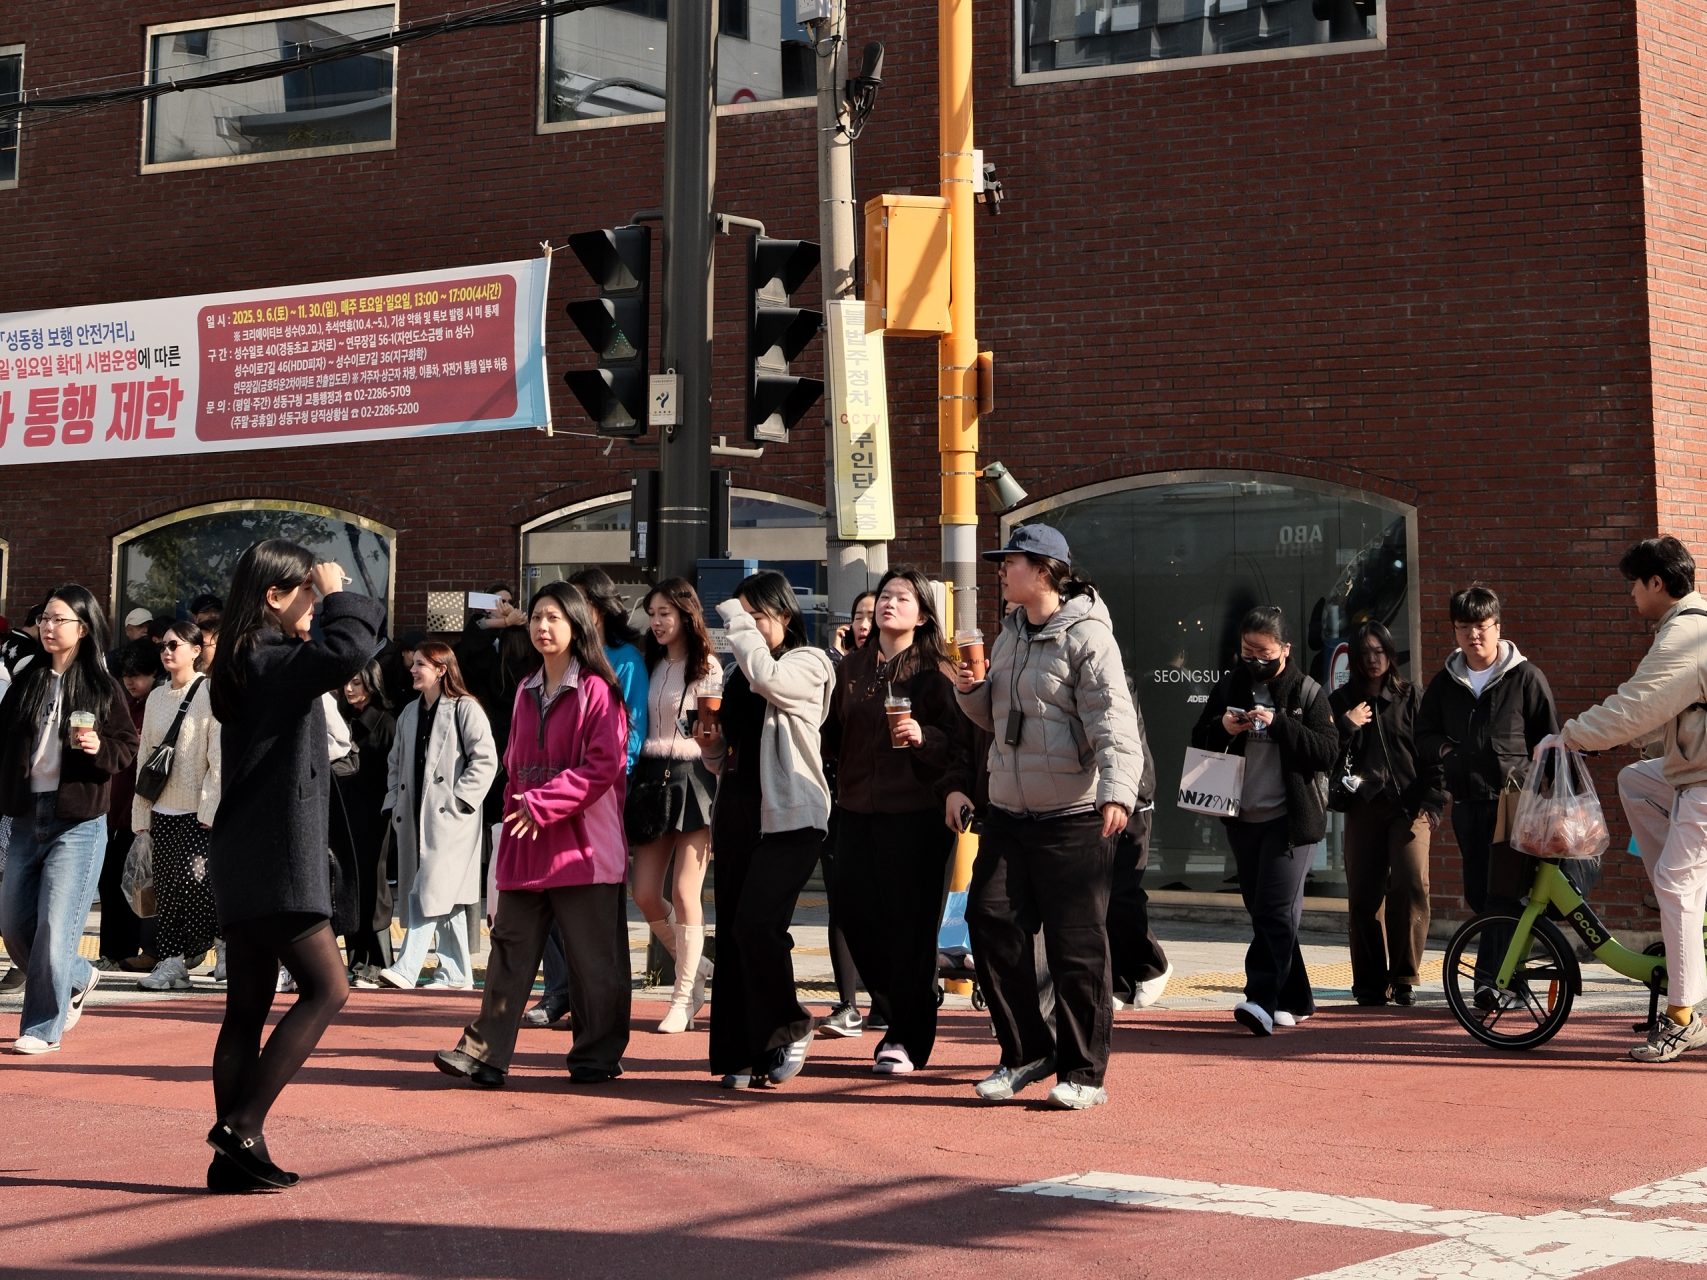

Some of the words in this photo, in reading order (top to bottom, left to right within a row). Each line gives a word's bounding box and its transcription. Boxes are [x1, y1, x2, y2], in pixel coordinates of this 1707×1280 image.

[415, 291, 438, 306] 13:00
[449, 283, 501, 302] 17:00(4시간)
[48, 325, 74, 348] 보행
[77, 320, 135, 346] 안전거리」
[446, 327, 453, 338] in
[56, 353, 83, 377] 확대
[154, 345, 182, 369] 따른
[354, 385, 411, 400] 02-2286-5709
[23, 382, 97, 448] 통행
[105, 375, 185, 442] 제한
[361, 402, 419, 417] 02-2286-5200
[840, 413, 881, 425] CCTV
[1154, 669, 1220, 683] SEONGSU
[1573, 911, 1602, 945] GCOO
